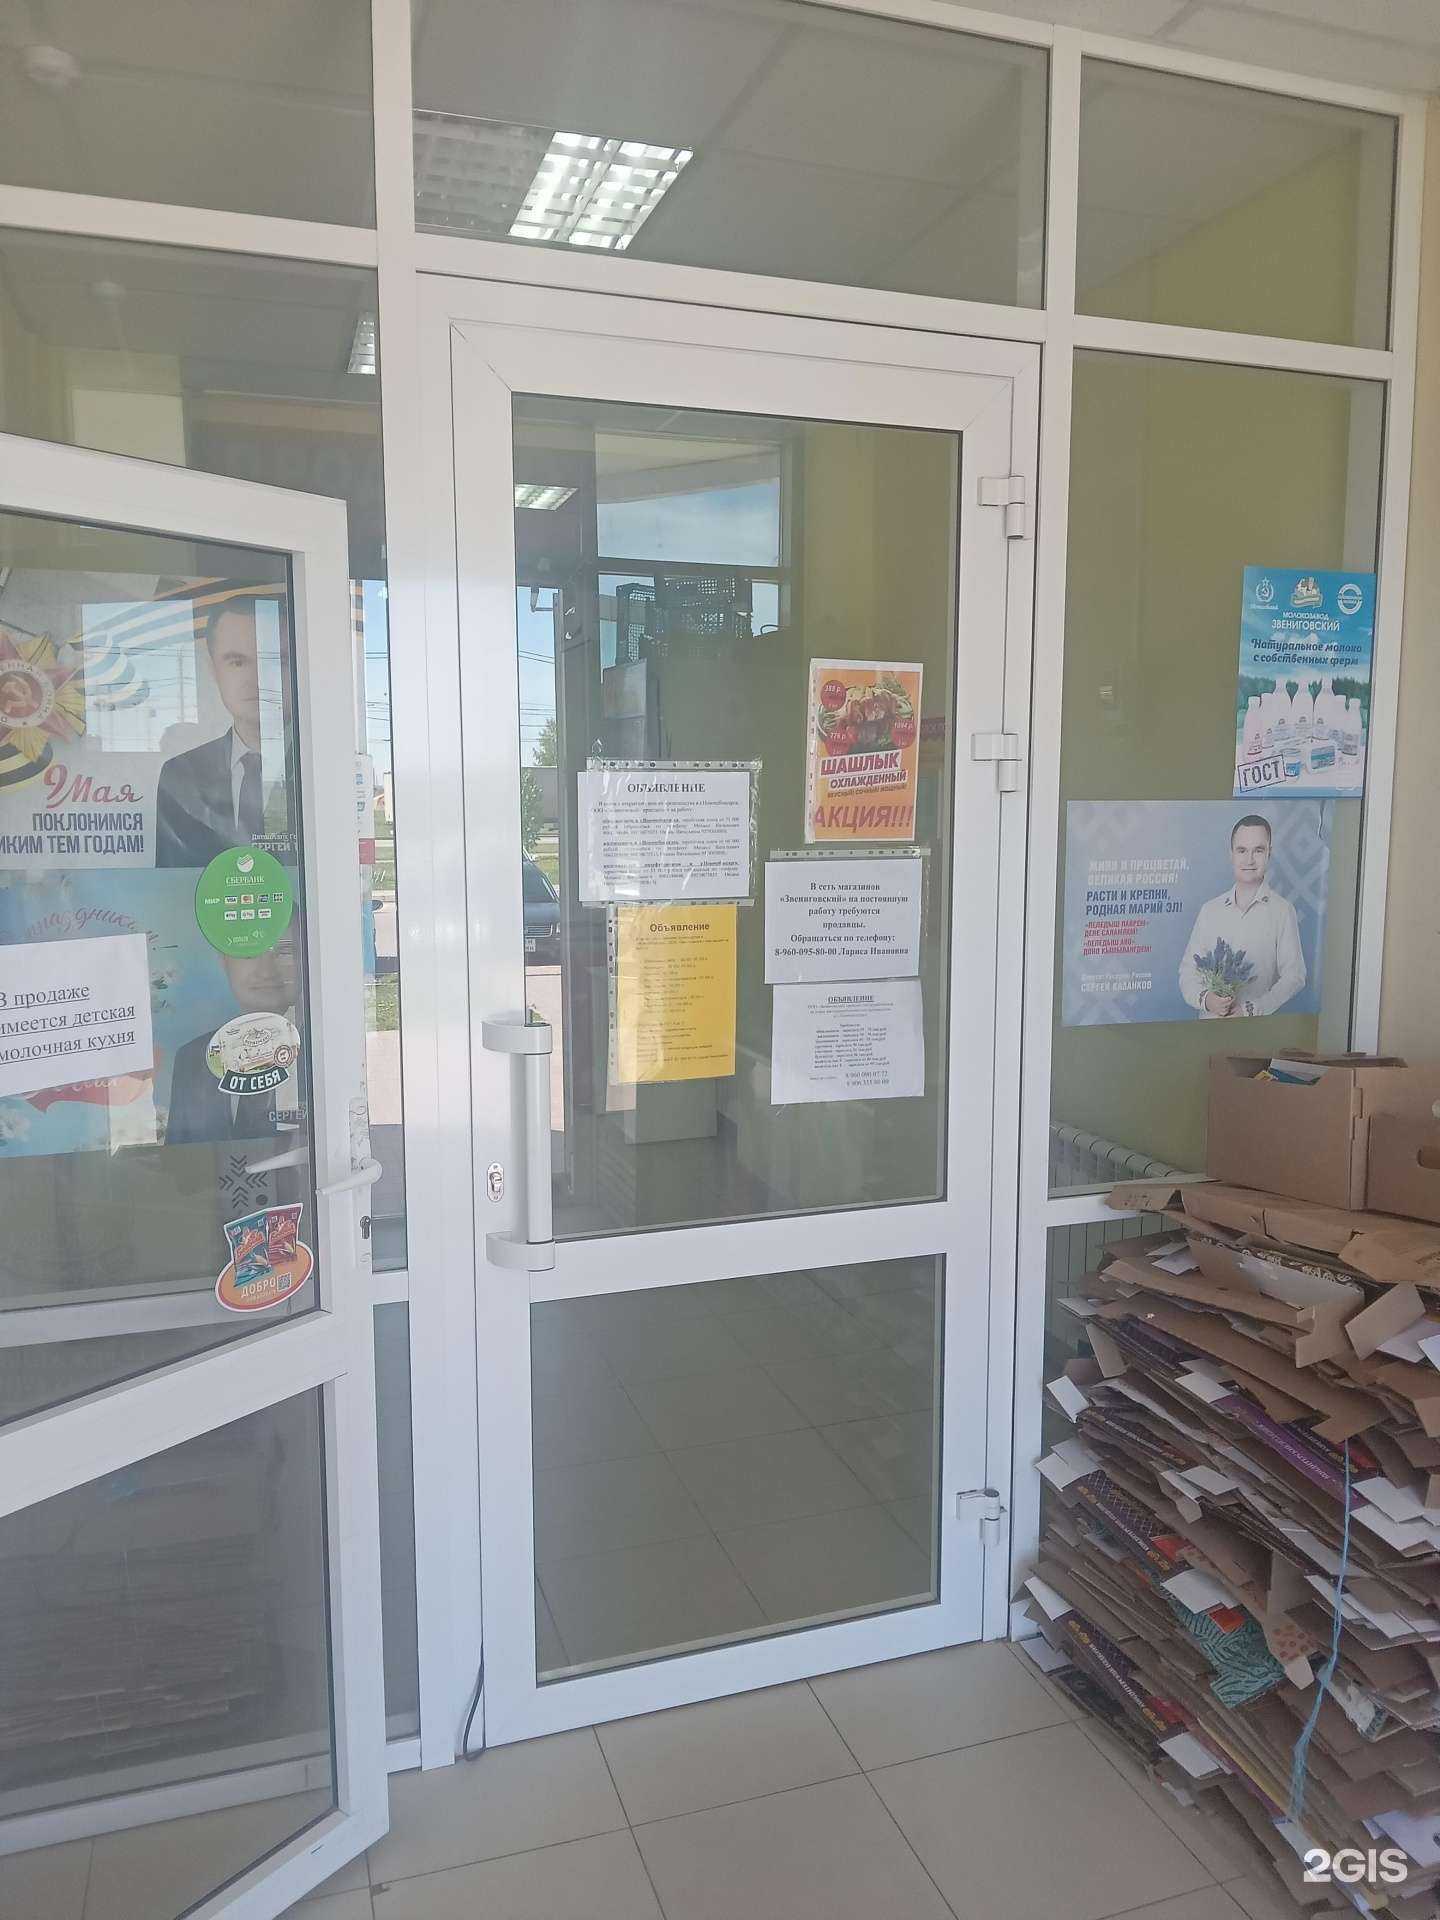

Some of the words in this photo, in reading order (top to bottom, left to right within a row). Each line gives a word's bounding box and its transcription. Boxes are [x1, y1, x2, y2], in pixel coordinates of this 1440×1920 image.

[1271, 620, 1340, 631] ЗВЕНИГОВСКИЙ
[1251, 639, 1323, 652] Натуральное
[1261, 654, 1328, 665] собственных
[821, 752, 900, 776] ШАШЛЫК
[830, 768, 907, 789] ОХЛАЖДЕННЫЙ
[1242, 760, 1280, 787] ГОСТ
[44, 764, 68, 801] 9
[627, 783, 705, 793] ОБЪЯВЛЕНИЕ
[46, 774, 143, 809] Мая
[32, 813, 143, 831] ПОКЛОНИМСЯ
[815, 805, 912, 833] АКЦИЯ!!!
[47, 836, 79, 853] ТЕМ
[84, 835, 144, 854] ГОДАМ!
[226, 876, 264, 885] СБЕРБАНК
[810, 883, 816, 891] В
[861, 896, 908, 905] постоянную
[1087, 890, 1117, 901] РАСТИ
[1120, 889, 1127, 900] И
[1130, 888, 1171, 901] КРЕПНИ,
[808, 907, 836, 916] работу
[839, 907, 880, 916] требуются
[1086, 903, 1126, 917] РОДНАЯ
[1128, 901, 1163, 914] МАРИЙ
[1166, 902, 1183, 912] ЭЛ!
[650, 923, 710, 932] Объявление
[823, 921, 866, 930] продавцы.
[790, 934, 841, 943] Обращаться
[856, 933, 896, 943] телефону:
[775, 948, 837, 956] 8-960-095-80-00
[838, 947, 868, 956] Лариса
[870, 946, 909, 955] Ивановна
[14, 986, 90, 1009] продаже
[72, 1005, 135, 1027] детская
[0, 1037, 81, 1061] молочная
[88, 1031, 135, 1050] кухня
[230, 1076, 246, 1090] ОТ
[251, 1070, 281, 1089] СЕБЯ
[241, 1277, 276, 1298] ДОБРО
